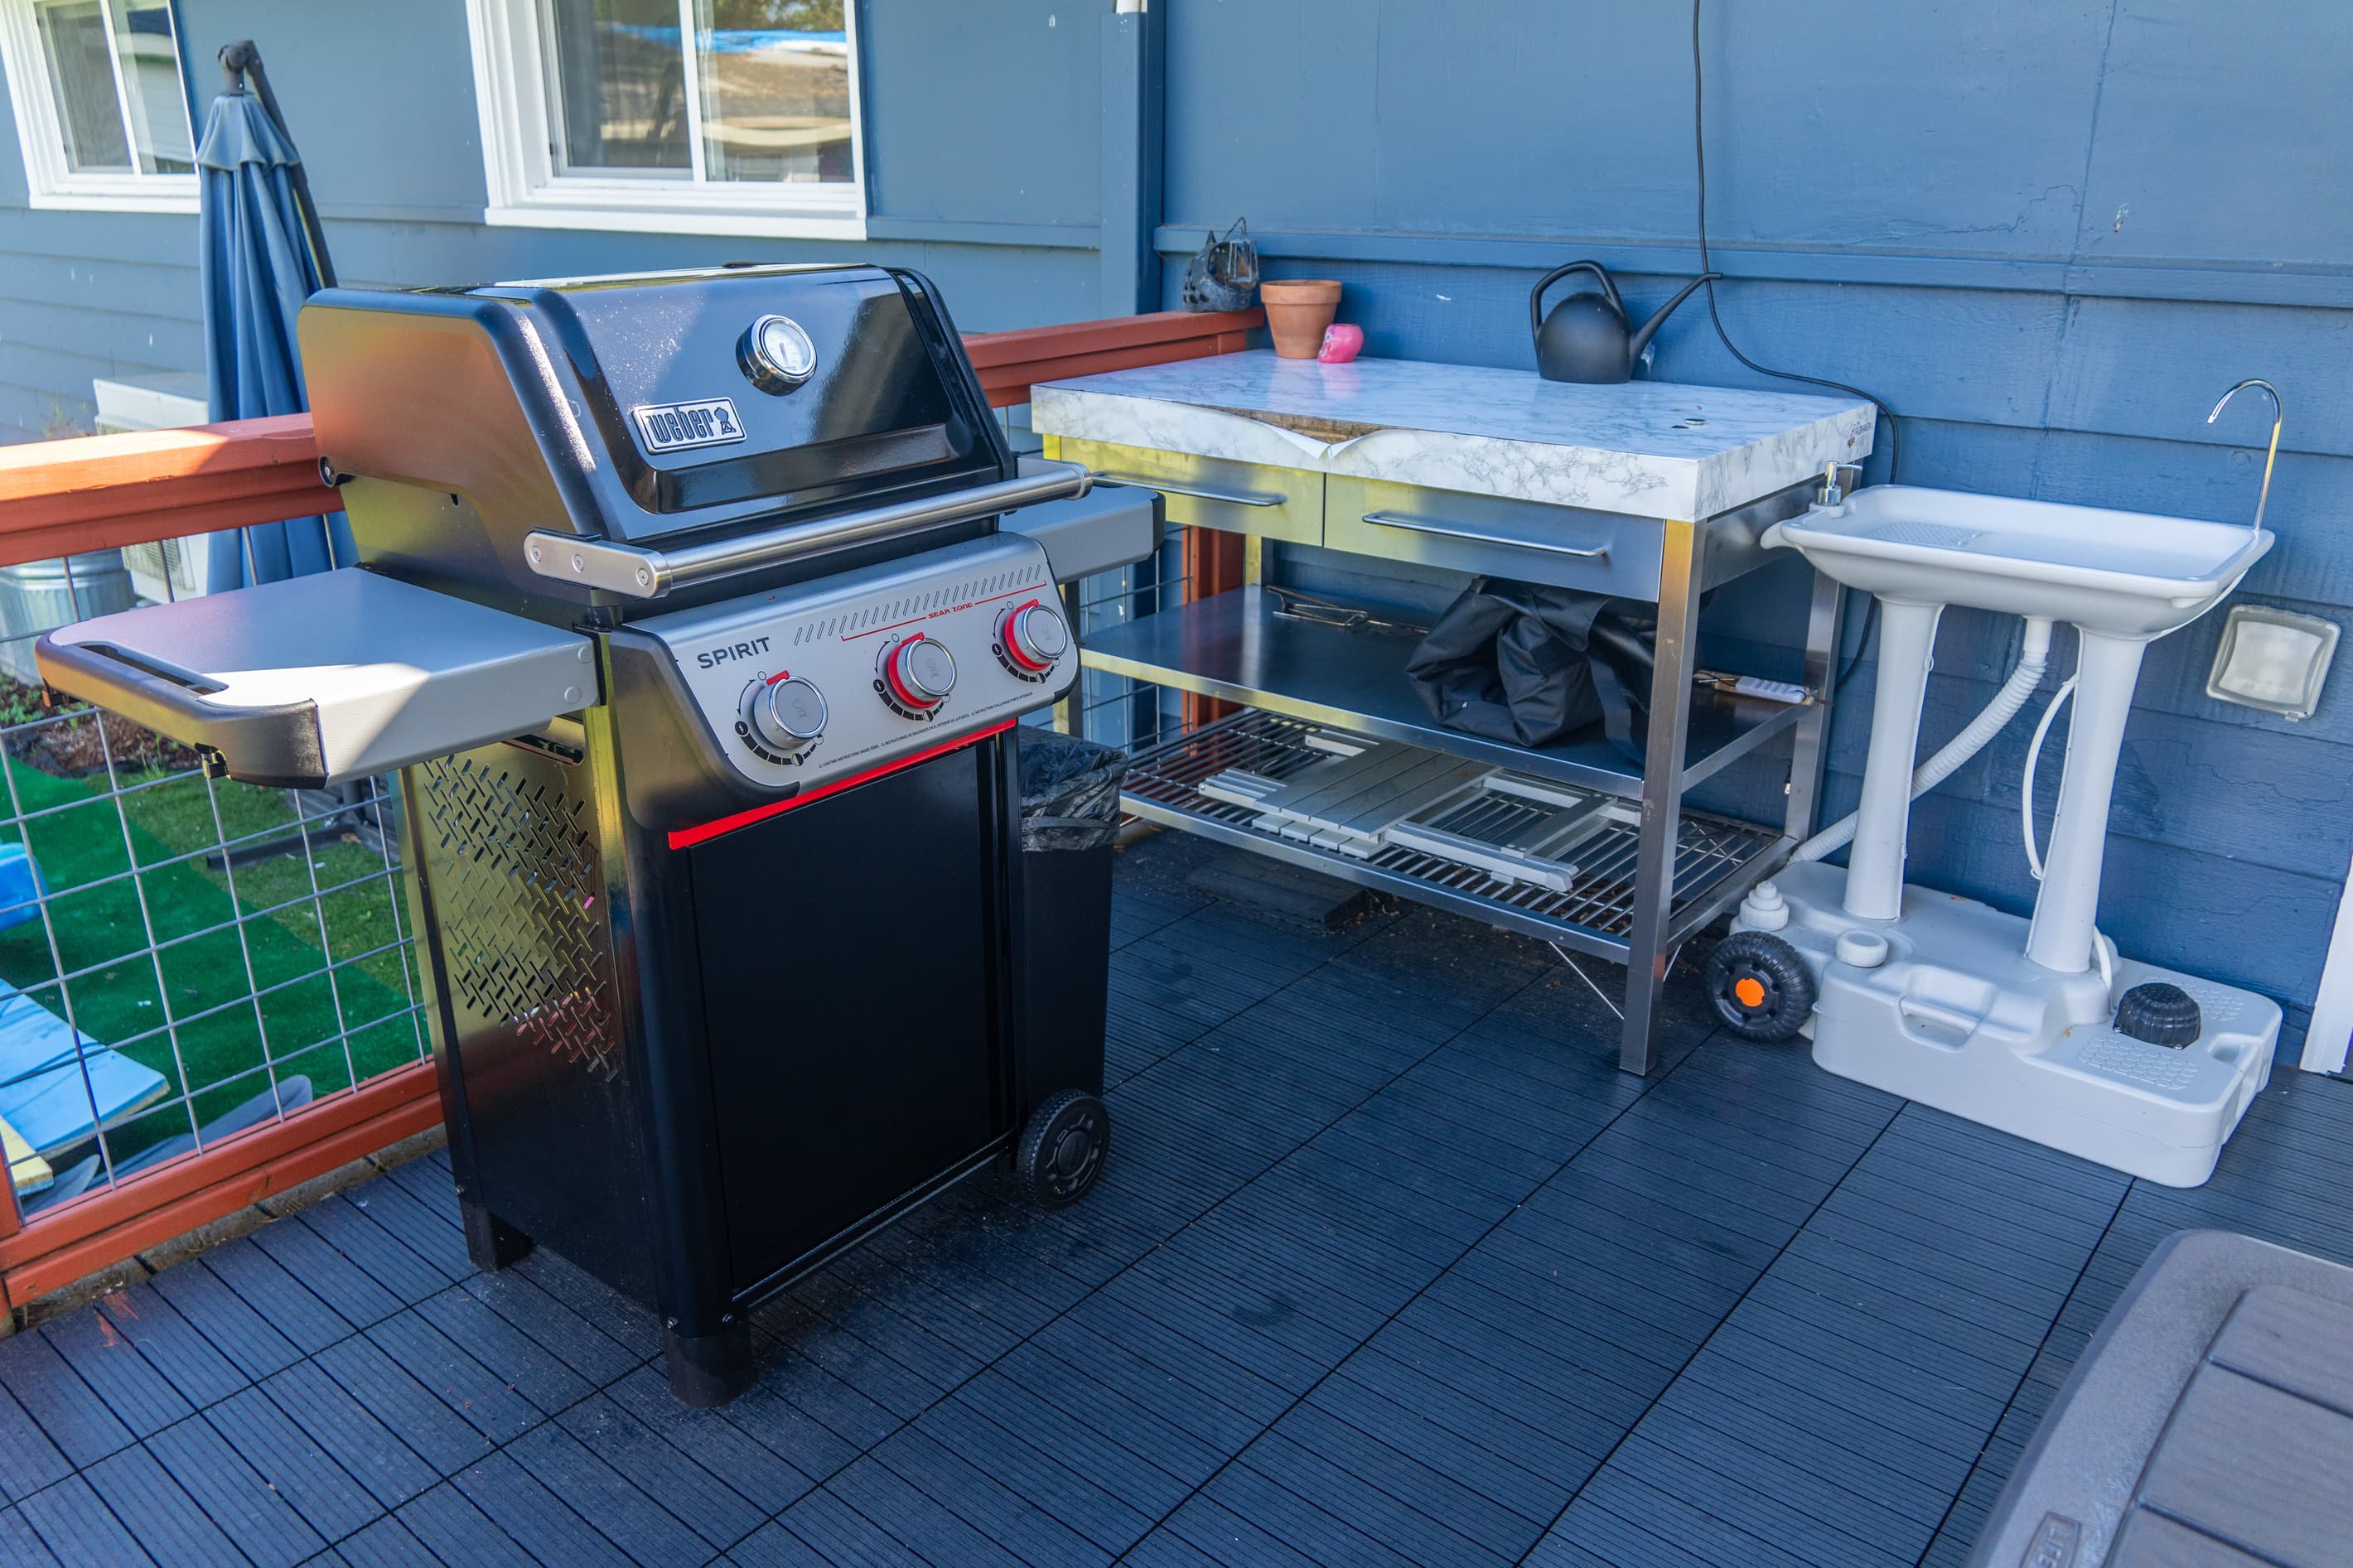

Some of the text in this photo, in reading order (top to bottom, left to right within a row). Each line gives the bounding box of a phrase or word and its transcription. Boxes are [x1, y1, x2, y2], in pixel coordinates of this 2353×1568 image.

[645, 405, 714, 443] weber
[928, 602, 973, 619] SEAR ZONE
[697, 636, 770, 668] SPIRIT
